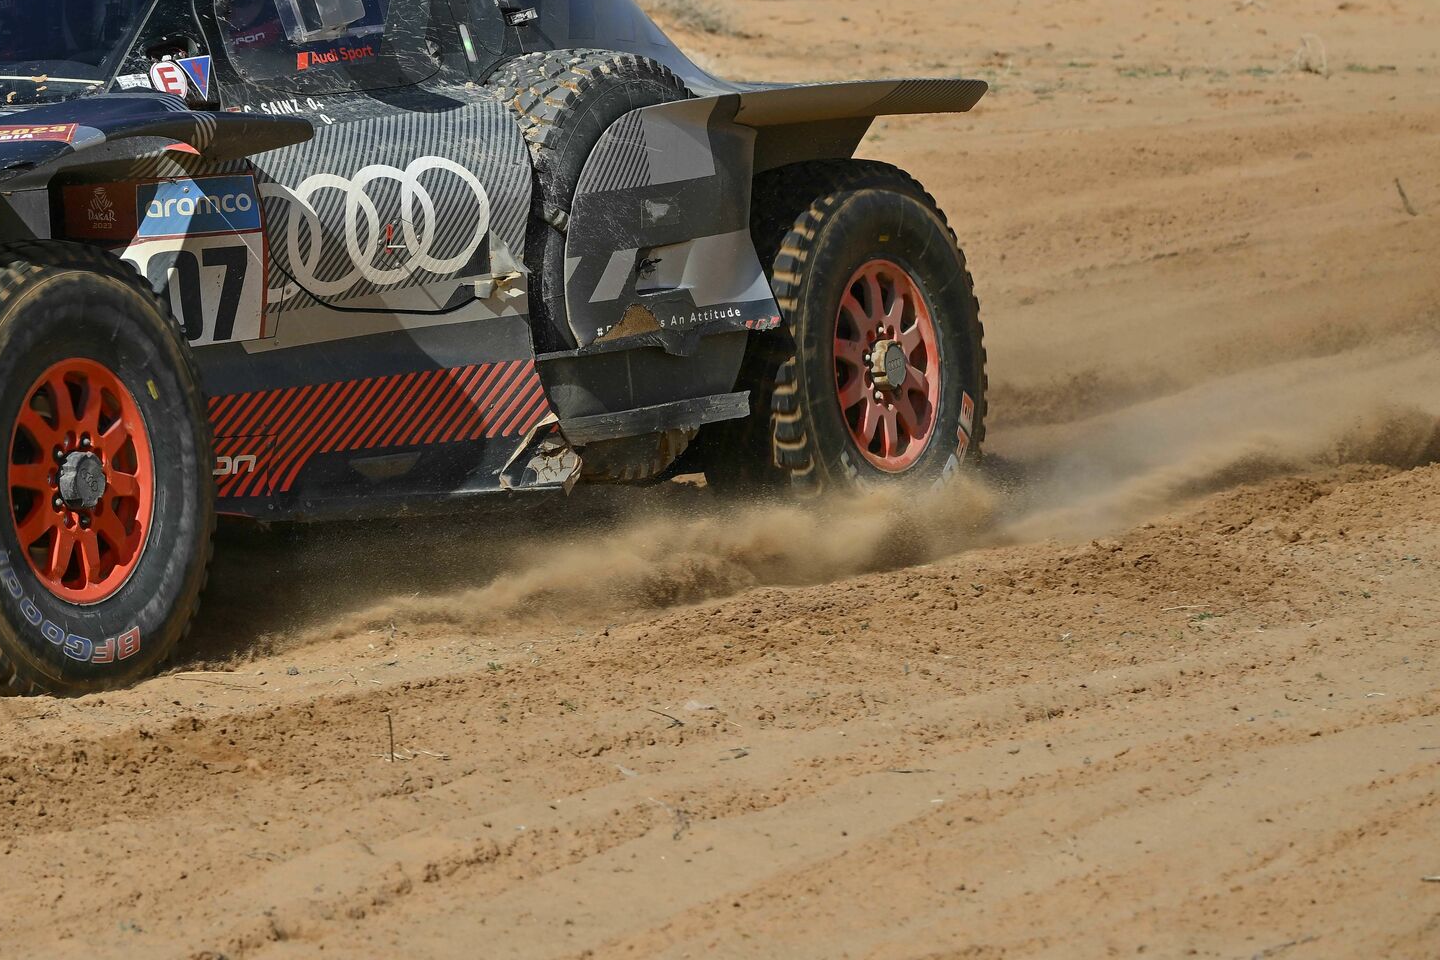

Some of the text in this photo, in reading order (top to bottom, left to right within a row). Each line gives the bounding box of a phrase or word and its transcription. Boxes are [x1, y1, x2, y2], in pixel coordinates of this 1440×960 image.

[311, 44, 374, 64] Audi Sport
[156, 66, 182, 95] E
[260, 98, 304, 115] SAINZ
[87, 208, 117, 222] DAKAR
[145, 193, 252, 219] aramco
[121, 245, 248, 341] 07
[670, 315, 685, 327] An
[689, 307, 742, 324] Attitude
